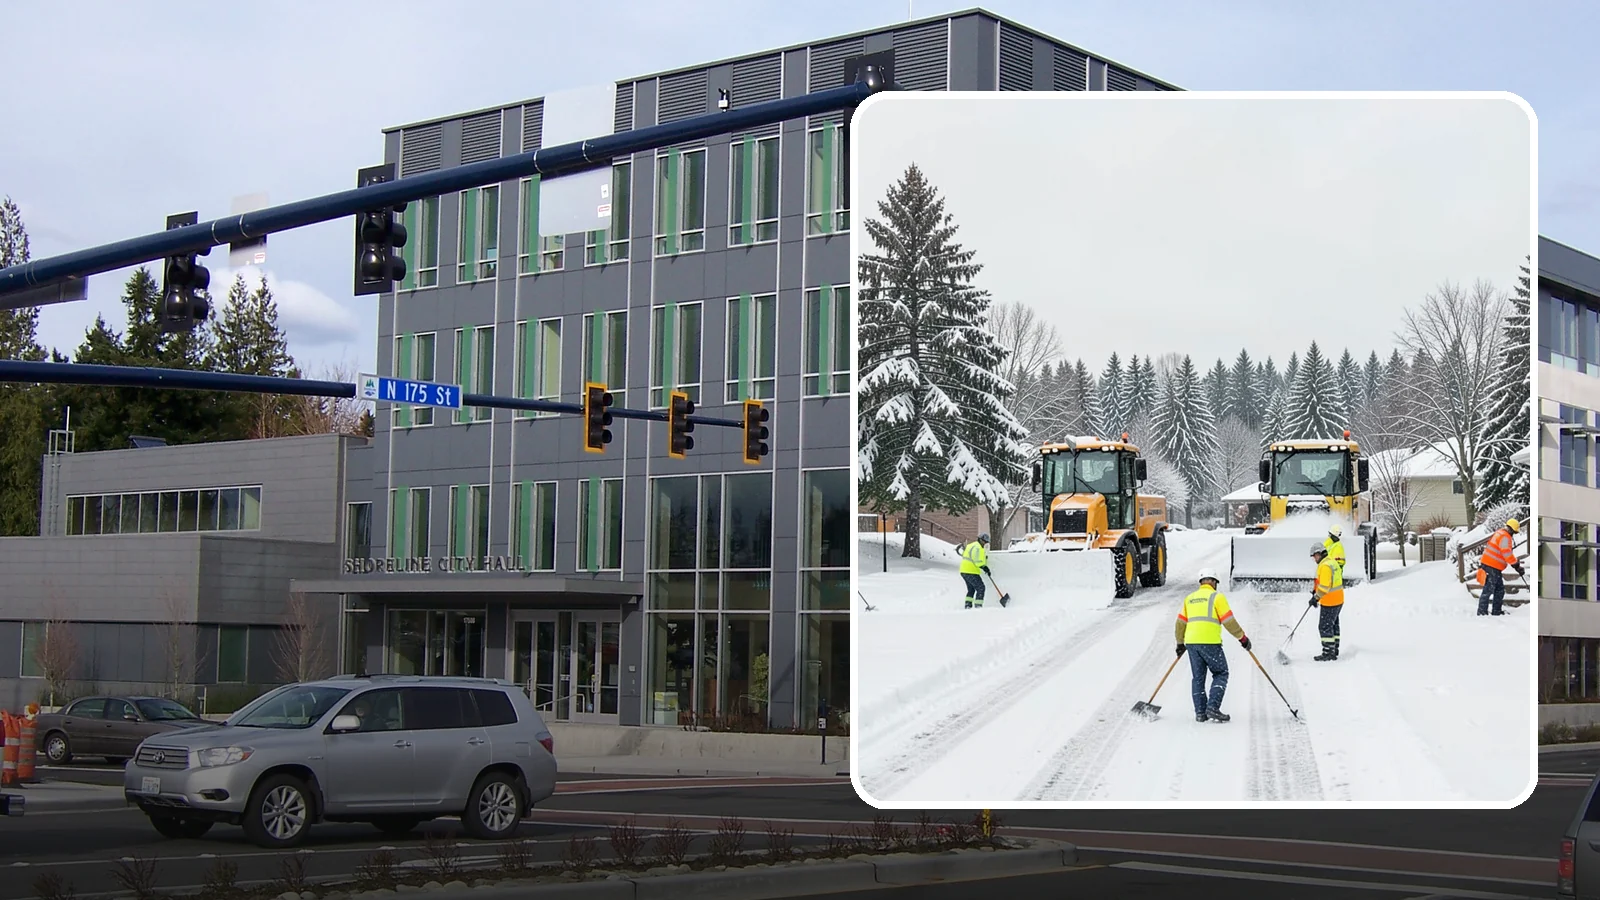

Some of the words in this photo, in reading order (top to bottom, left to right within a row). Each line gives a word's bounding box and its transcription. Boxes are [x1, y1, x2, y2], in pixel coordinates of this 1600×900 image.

[387, 380, 396, 400] N
[405, 382, 427, 403] 175
[436, 386, 451, 406] St
[344, 556, 432, 574] SHORELINE
[438, 556, 476, 572] CITY
[485, 555, 525, 571] HALL
